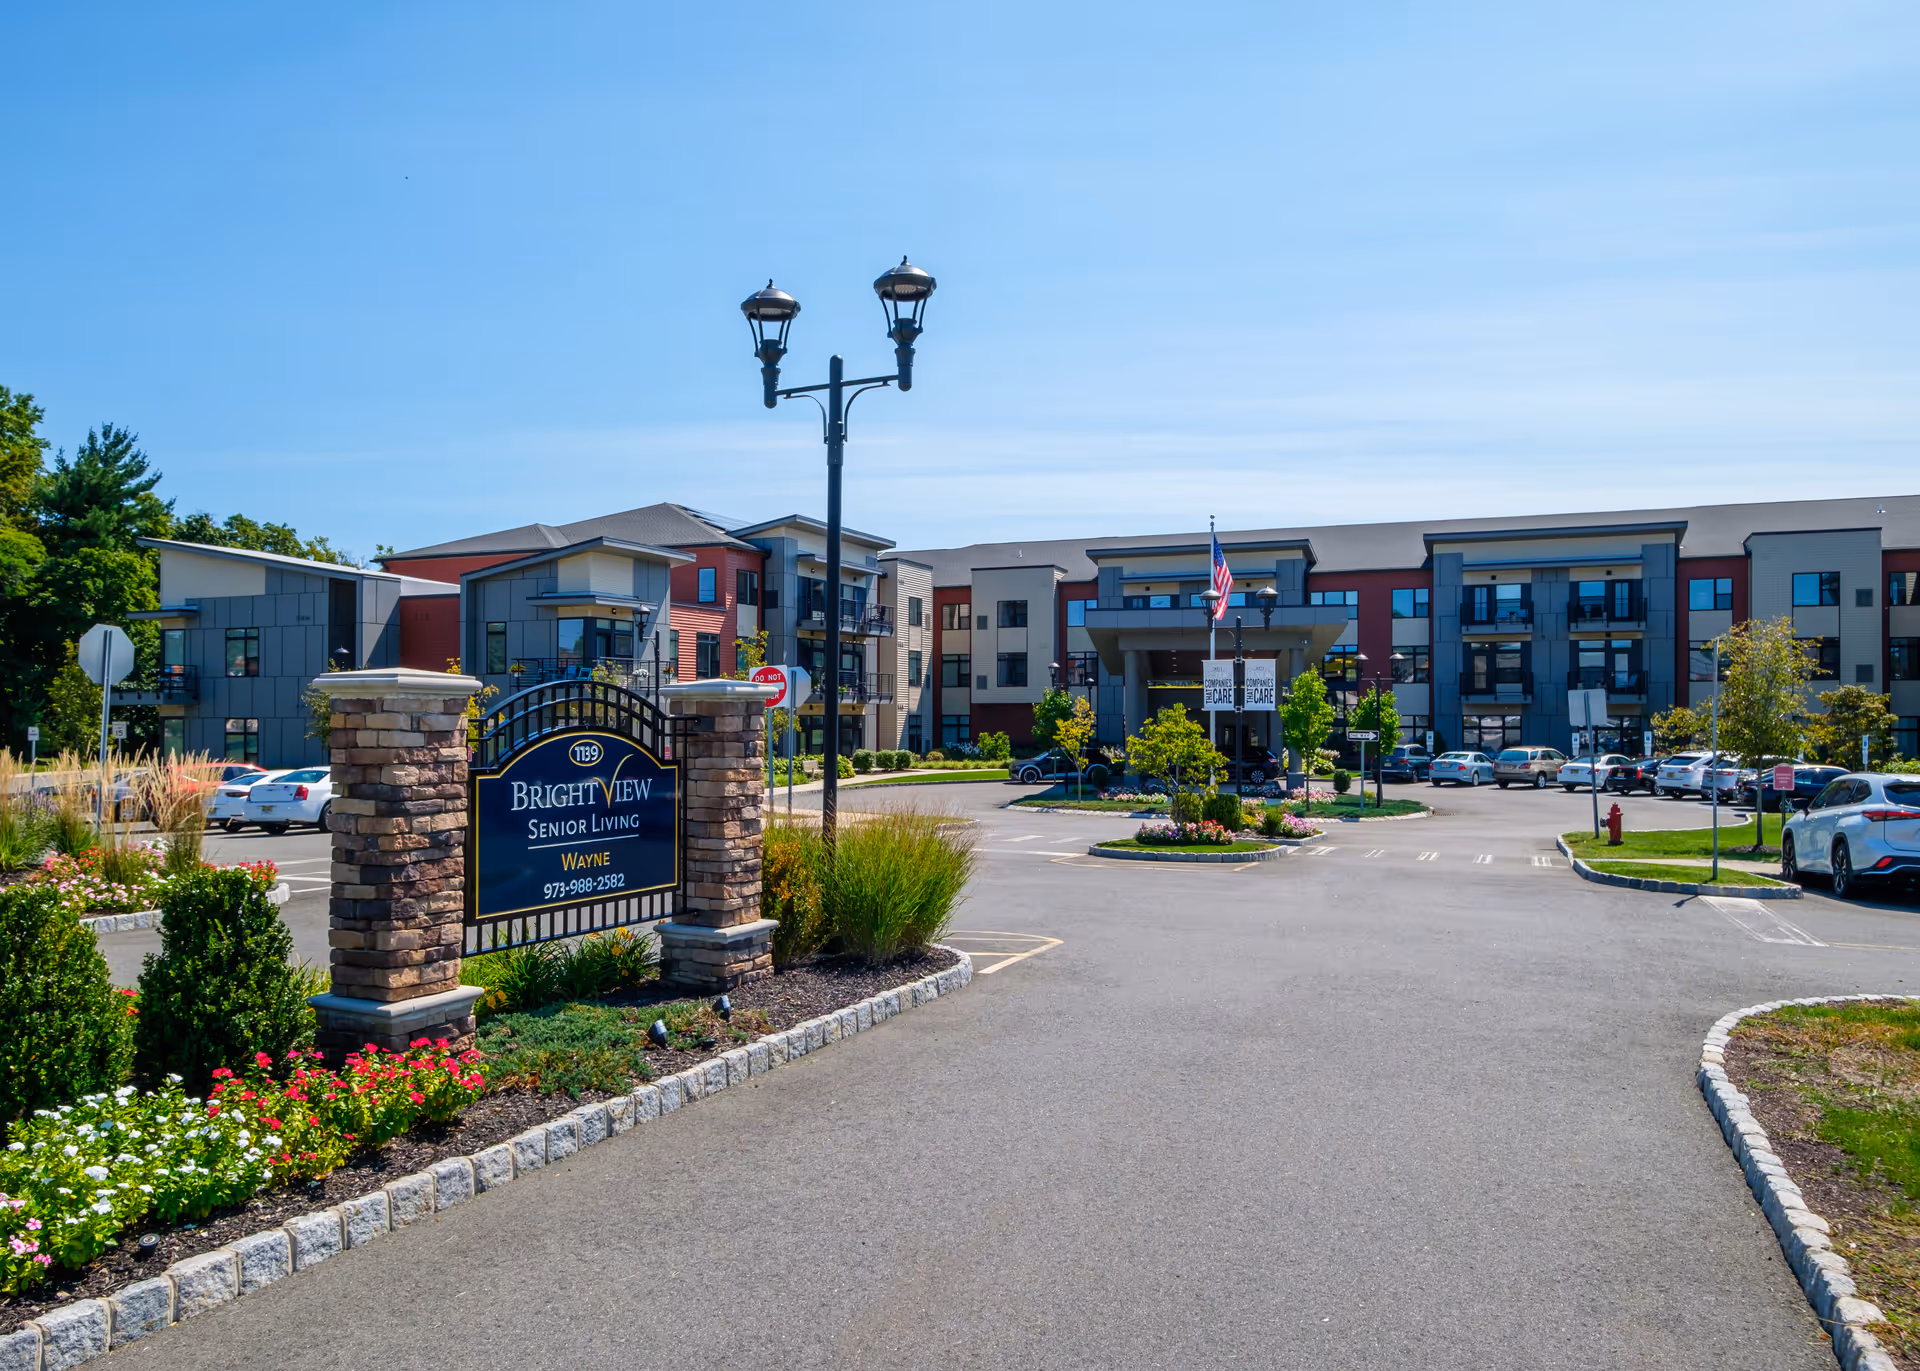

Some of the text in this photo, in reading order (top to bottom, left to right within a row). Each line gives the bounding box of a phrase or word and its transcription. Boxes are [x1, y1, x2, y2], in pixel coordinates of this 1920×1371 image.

[767, 673, 782, 681] NOT
[1205, 679, 1232, 688] COMPANIES
[1246, 678, 1274, 688] COMPANIES
[1212, 688, 1232, 704] CARE
[1254, 688, 1274, 704] CARE
[574, 745, 599, 761] 1139
[528, 814, 639, 839] SENIOR LIVING
[561, 852, 610, 871] WAYNE
[543, 873, 625, 899] 973-988-2582
